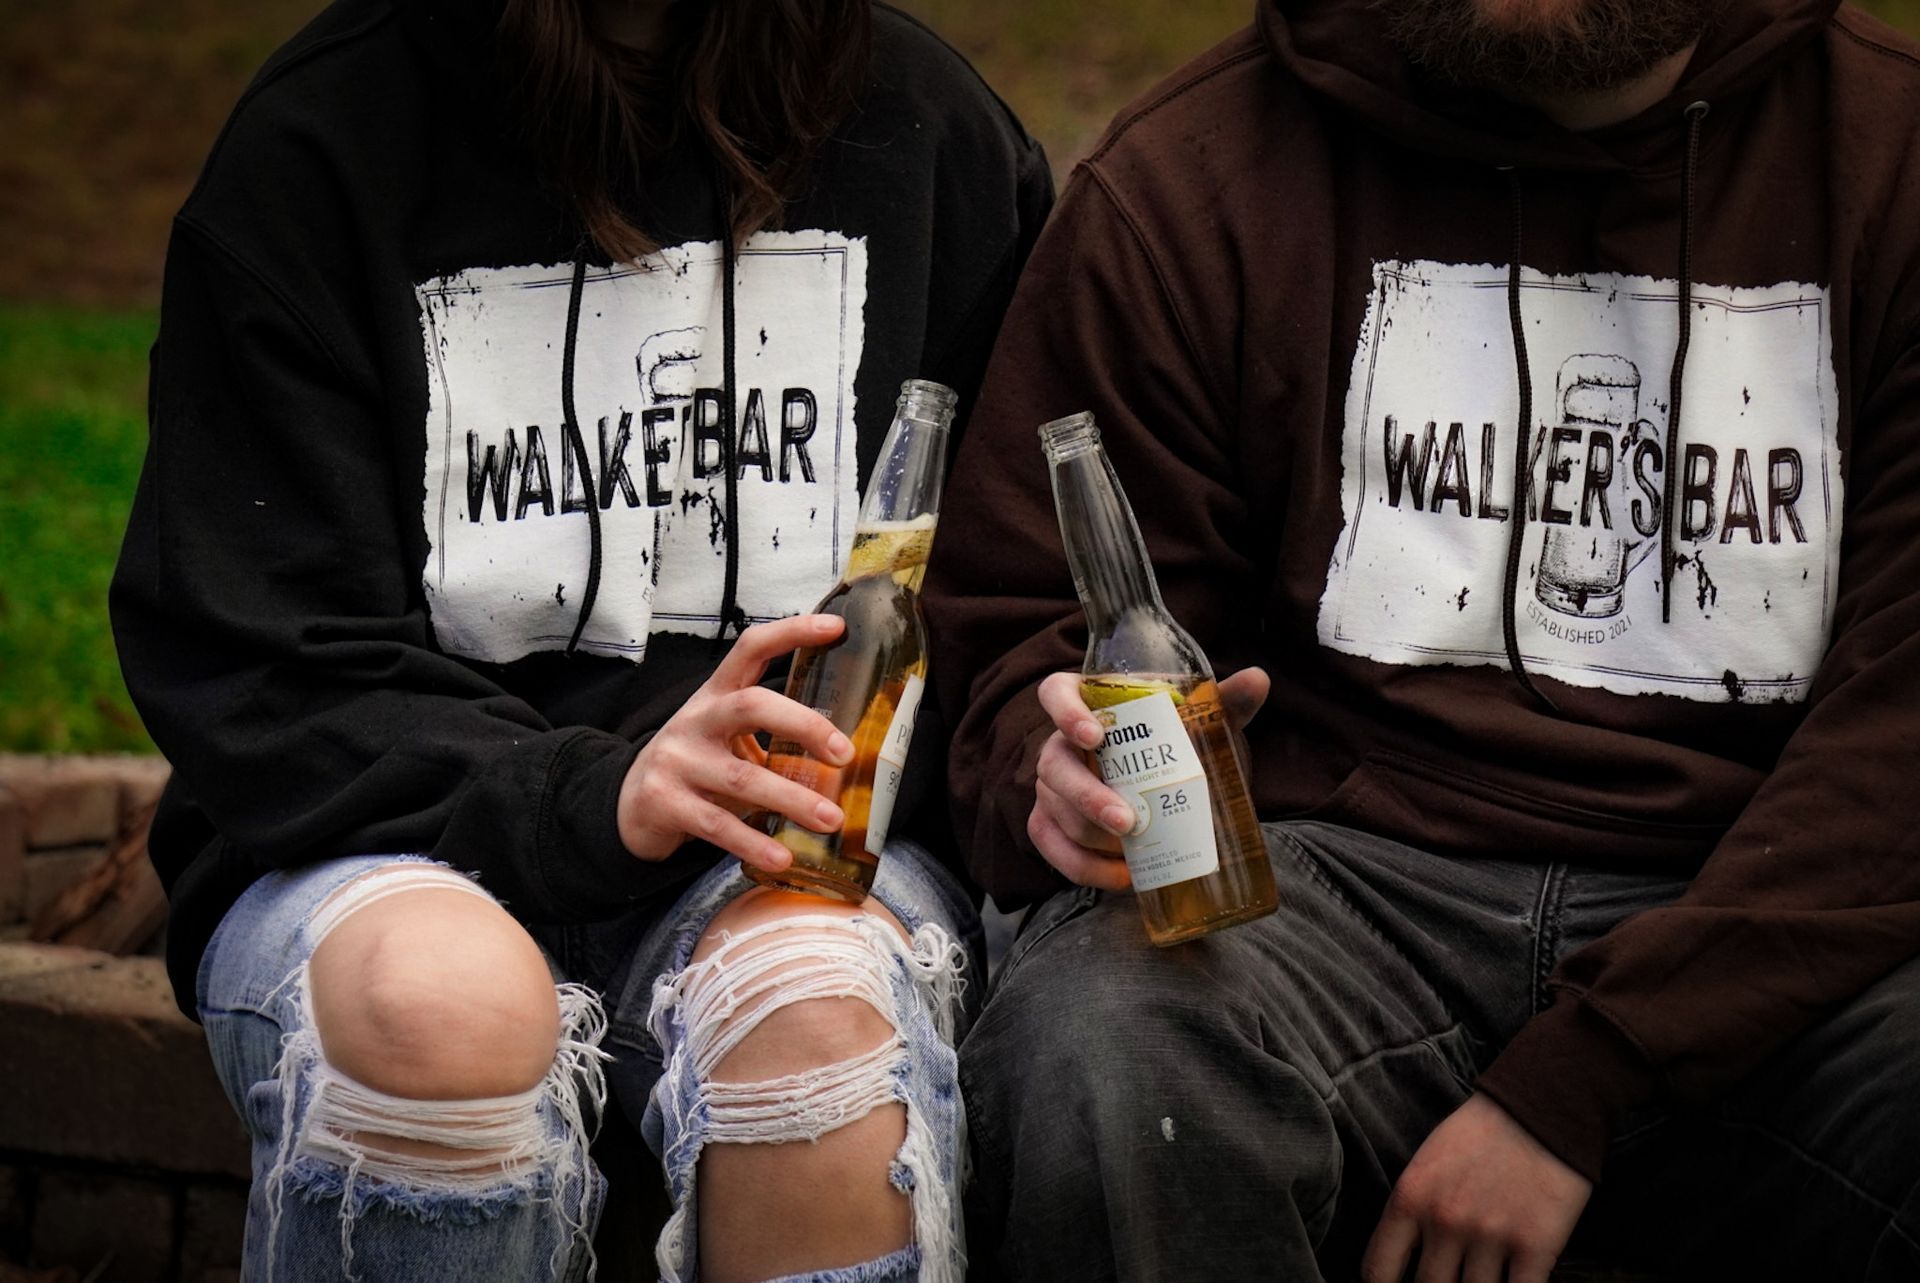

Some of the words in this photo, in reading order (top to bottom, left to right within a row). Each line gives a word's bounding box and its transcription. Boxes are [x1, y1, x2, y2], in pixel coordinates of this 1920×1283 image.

[466, 404, 691, 523] WALKE
[692, 387, 817, 483] BAR
[1680, 442, 1808, 544] BAR
[1526, 601, 1605, 644] ESTABLISHED
[1608, 615, 1633, 640] 2021
[1160, 789, 1187, 810] 2.6
